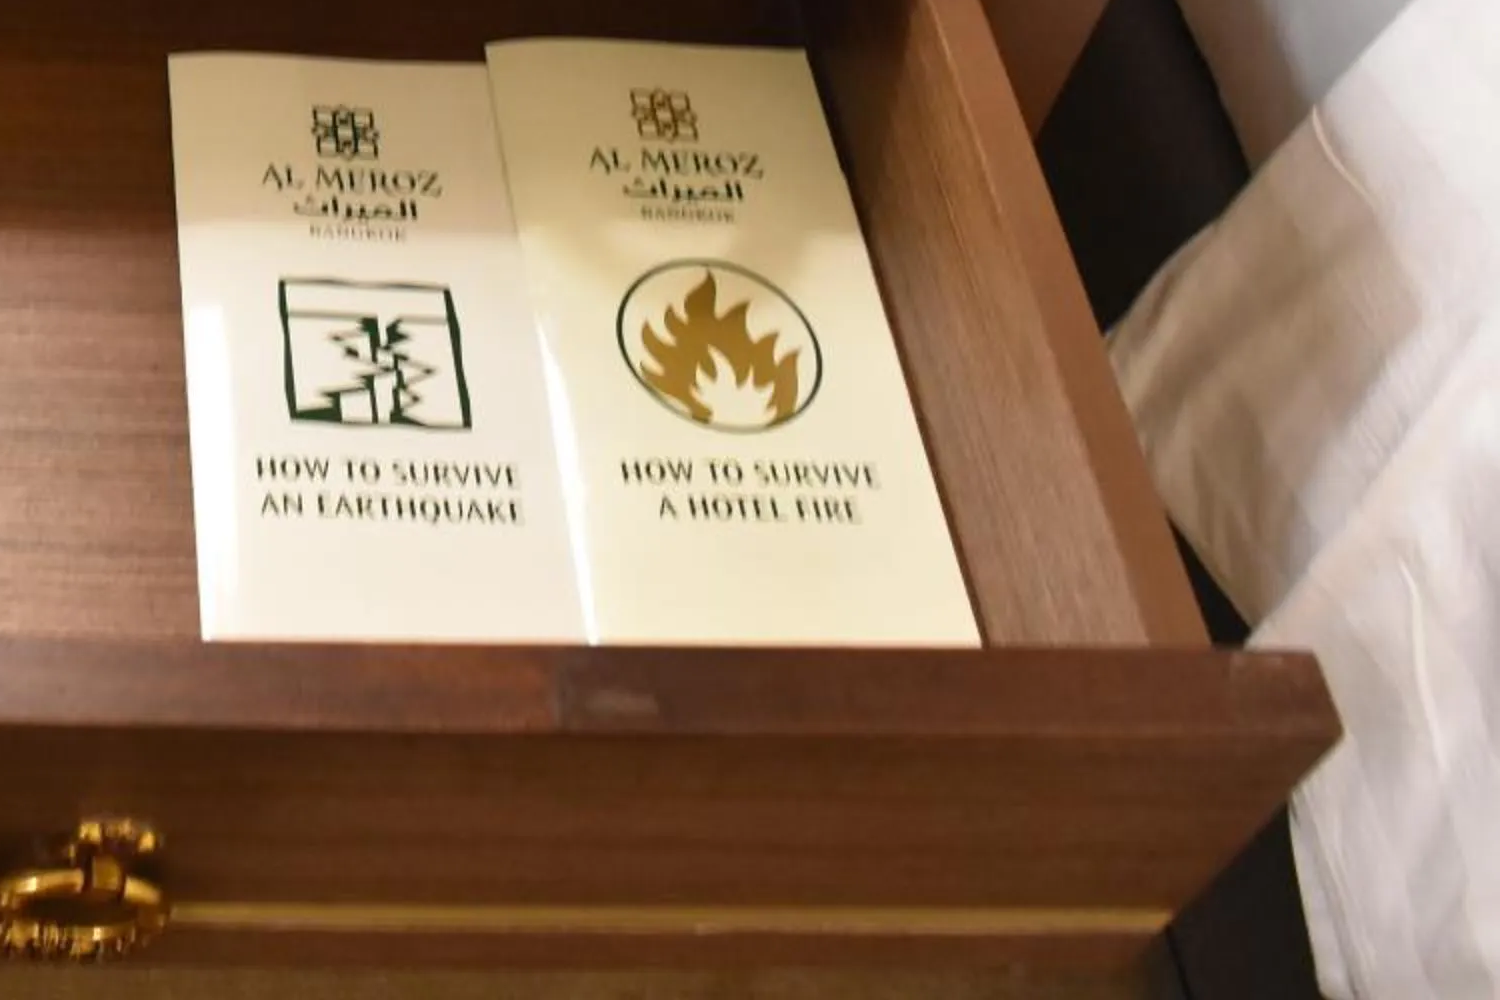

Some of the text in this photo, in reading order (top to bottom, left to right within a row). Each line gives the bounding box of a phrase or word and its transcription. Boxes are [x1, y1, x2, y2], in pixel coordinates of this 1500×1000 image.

[589, 145, 632, 175] AL
[262, 161, 304, 192] AL
[256, 456, 522, 490] HOW TO SURVIVE
[619, 457, 882, 490] HOW TO SURVIVE
[260, 491, 526, 527] AN EARTHQUAKE
[658, 494, 863, 525] A HOTEL FIRE
